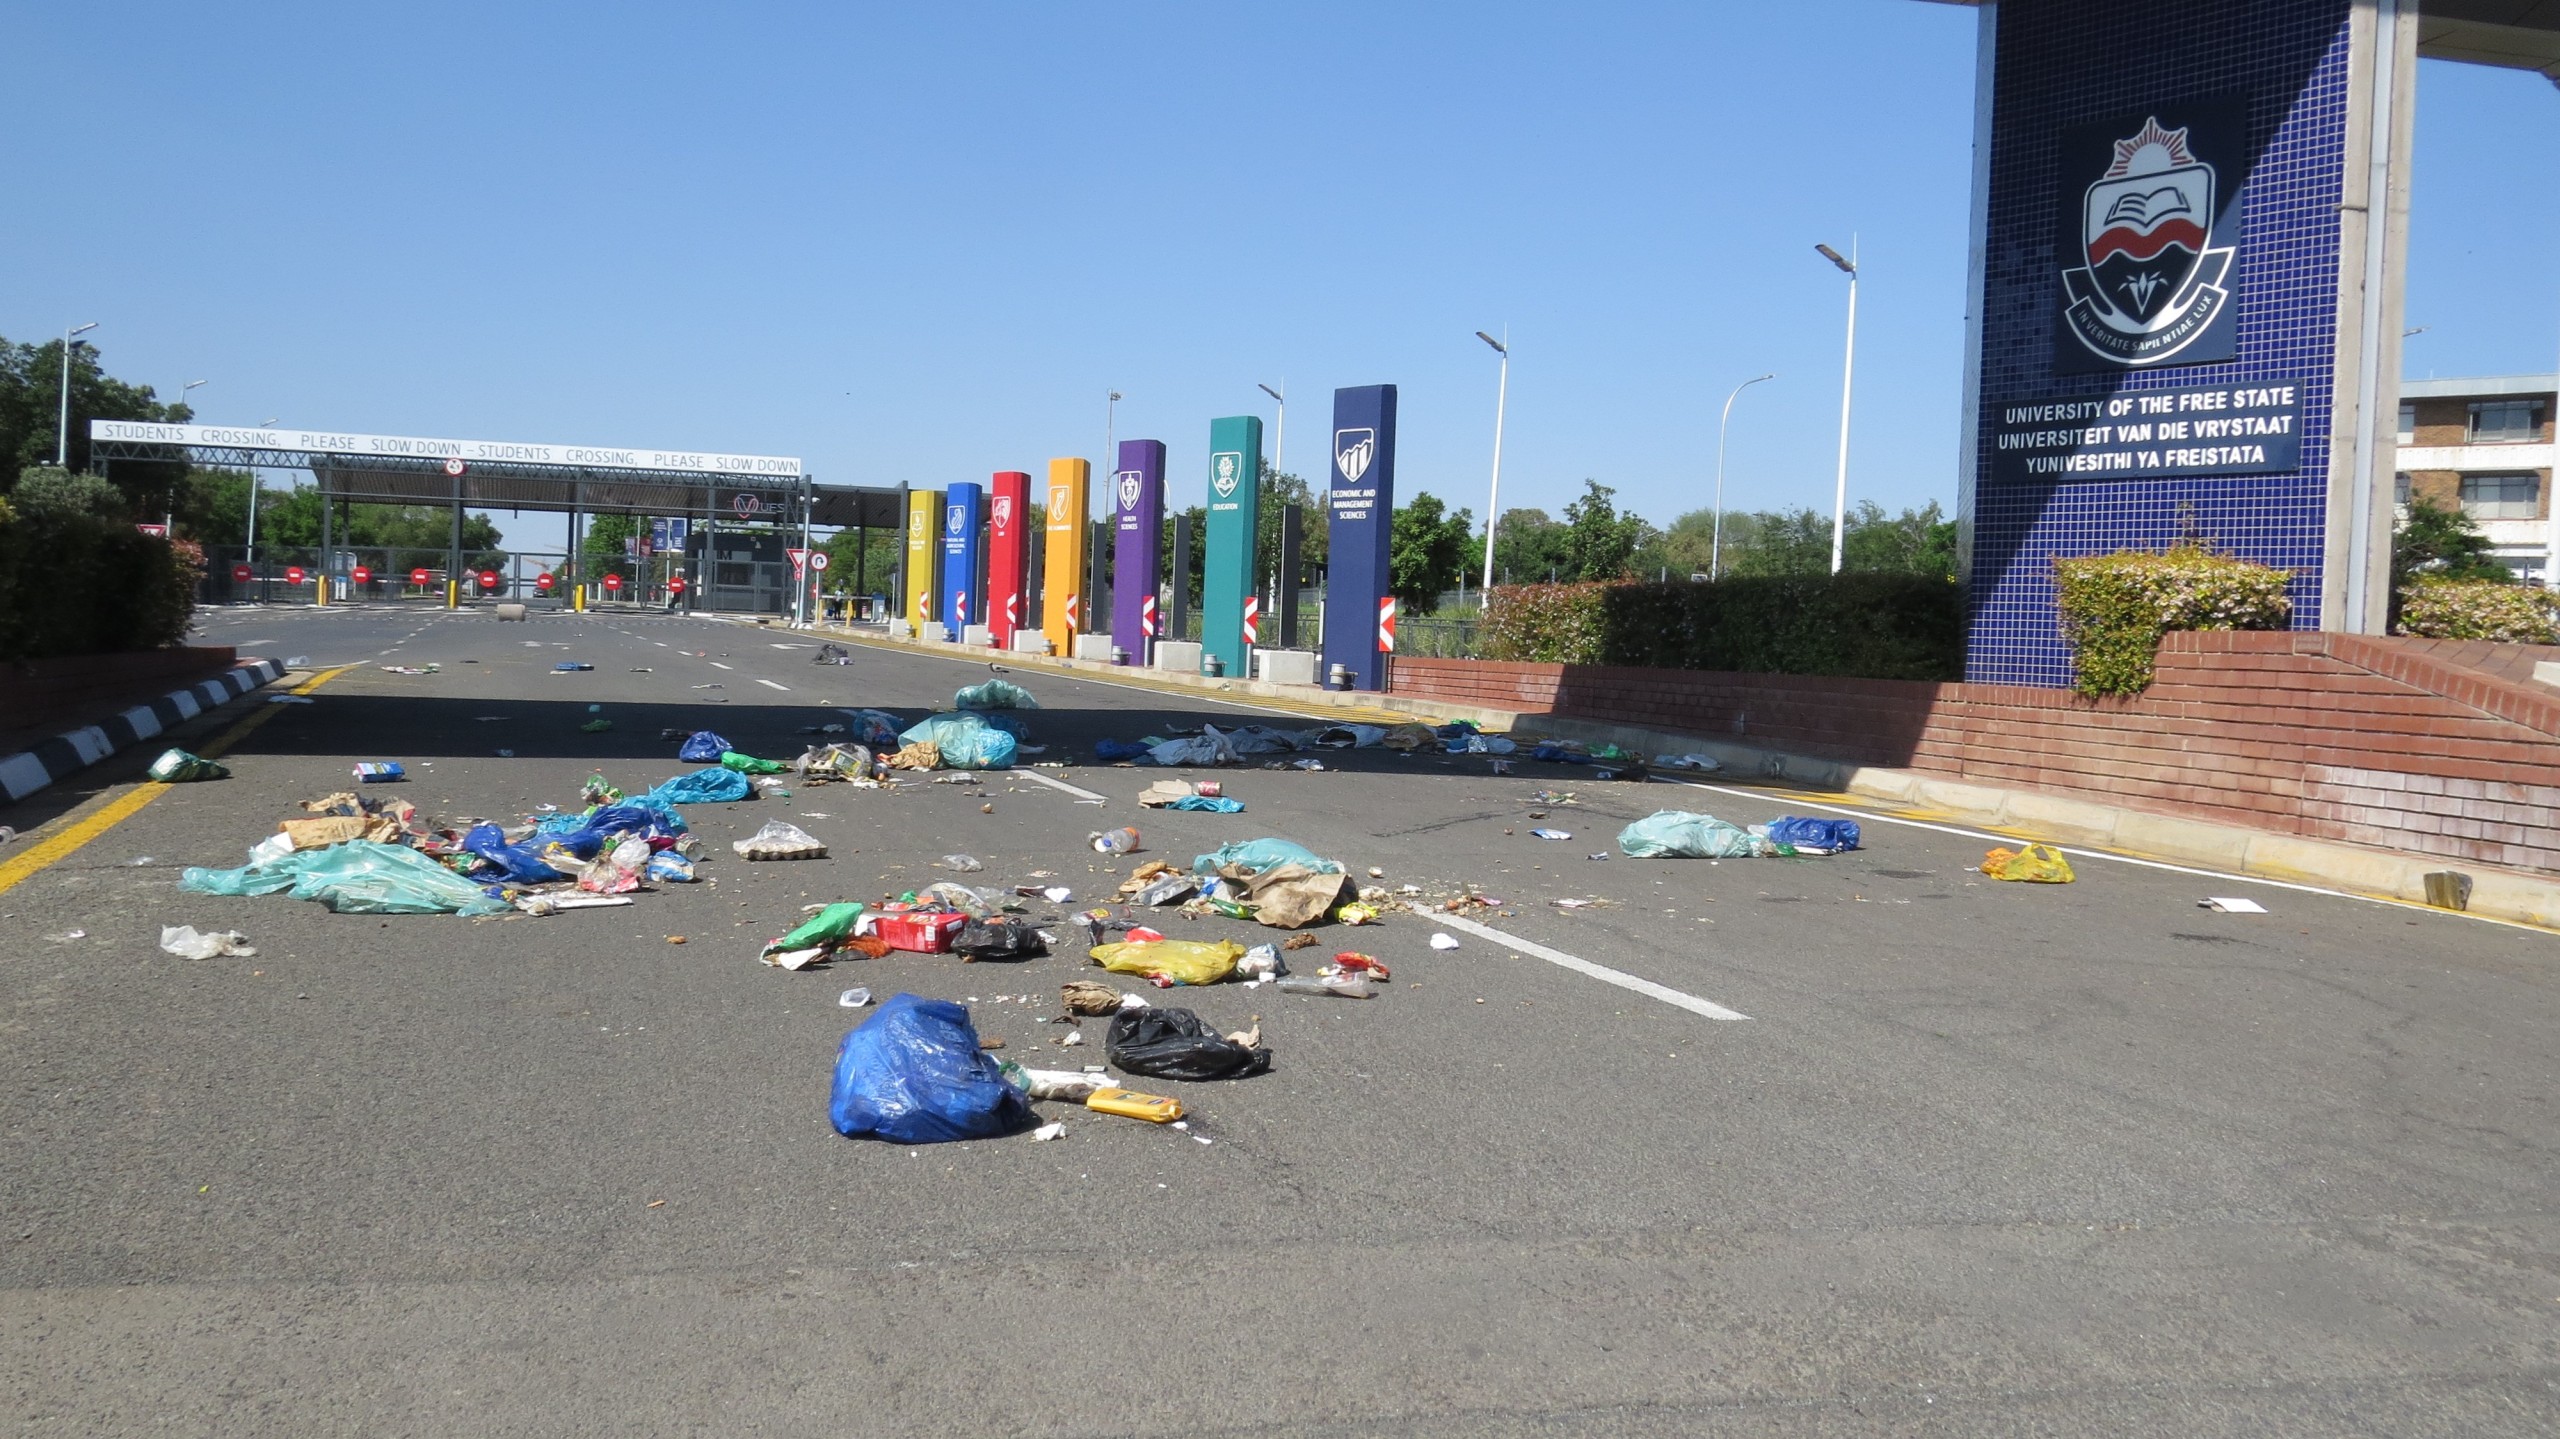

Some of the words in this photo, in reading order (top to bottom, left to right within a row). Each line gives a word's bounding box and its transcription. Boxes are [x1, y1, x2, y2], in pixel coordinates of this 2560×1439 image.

[2078, 309, 2088, 323] IN
[2086, 319, 2129, 351] VERITATE
[2193, 295, 2212, 319] LUX
[2006, 401, 2104, 424] UNIVERSITY
[2109, 398, 2133, 417] OF
[2138, 395, 2173, 414] THE
[2179, 391, 2228, 412] FREE
[2233, 386, 2294, 408] STATE
[1999, 426, 2112, 450] UNIVERSITEIT
[2117, 423, 2152, 443] VAN
[2158, 421, 2189, 440] DIE
[2194, 415, 2293, 438] VRYSTAAT
[105, 424, 184, 441] STUDENTS
[201, 429, 281, 448] CROSSING,
[301, 434, 356, 450] PLEASE
[371, 438, 412, 452] SLOW
[416, 441, 461, 455] DOWN
[478, 444, 550, 461] STUDENTS
[566, 449, 638, 467] CROSSING,
[654, 453, 704, 468] PLEASE
[716, 456, 753, 470] SLOW
[758, 460, 798, 473] DOWN
[2026, 451, 2132, 474] YUNIVESITHI
[2137, 451, 2160, 469] YA
[2165, 445, 2265, 467] FREISTATA
[760, 502, 785, 513] UFS
[1332, 489, 1362, 498] ECONOMIC
[1363, 488, 1376, 497] AND
[1333, 500, 1373, 509] MANAGEMENT
[1339, 511, 1367, 520] SCIENCES
